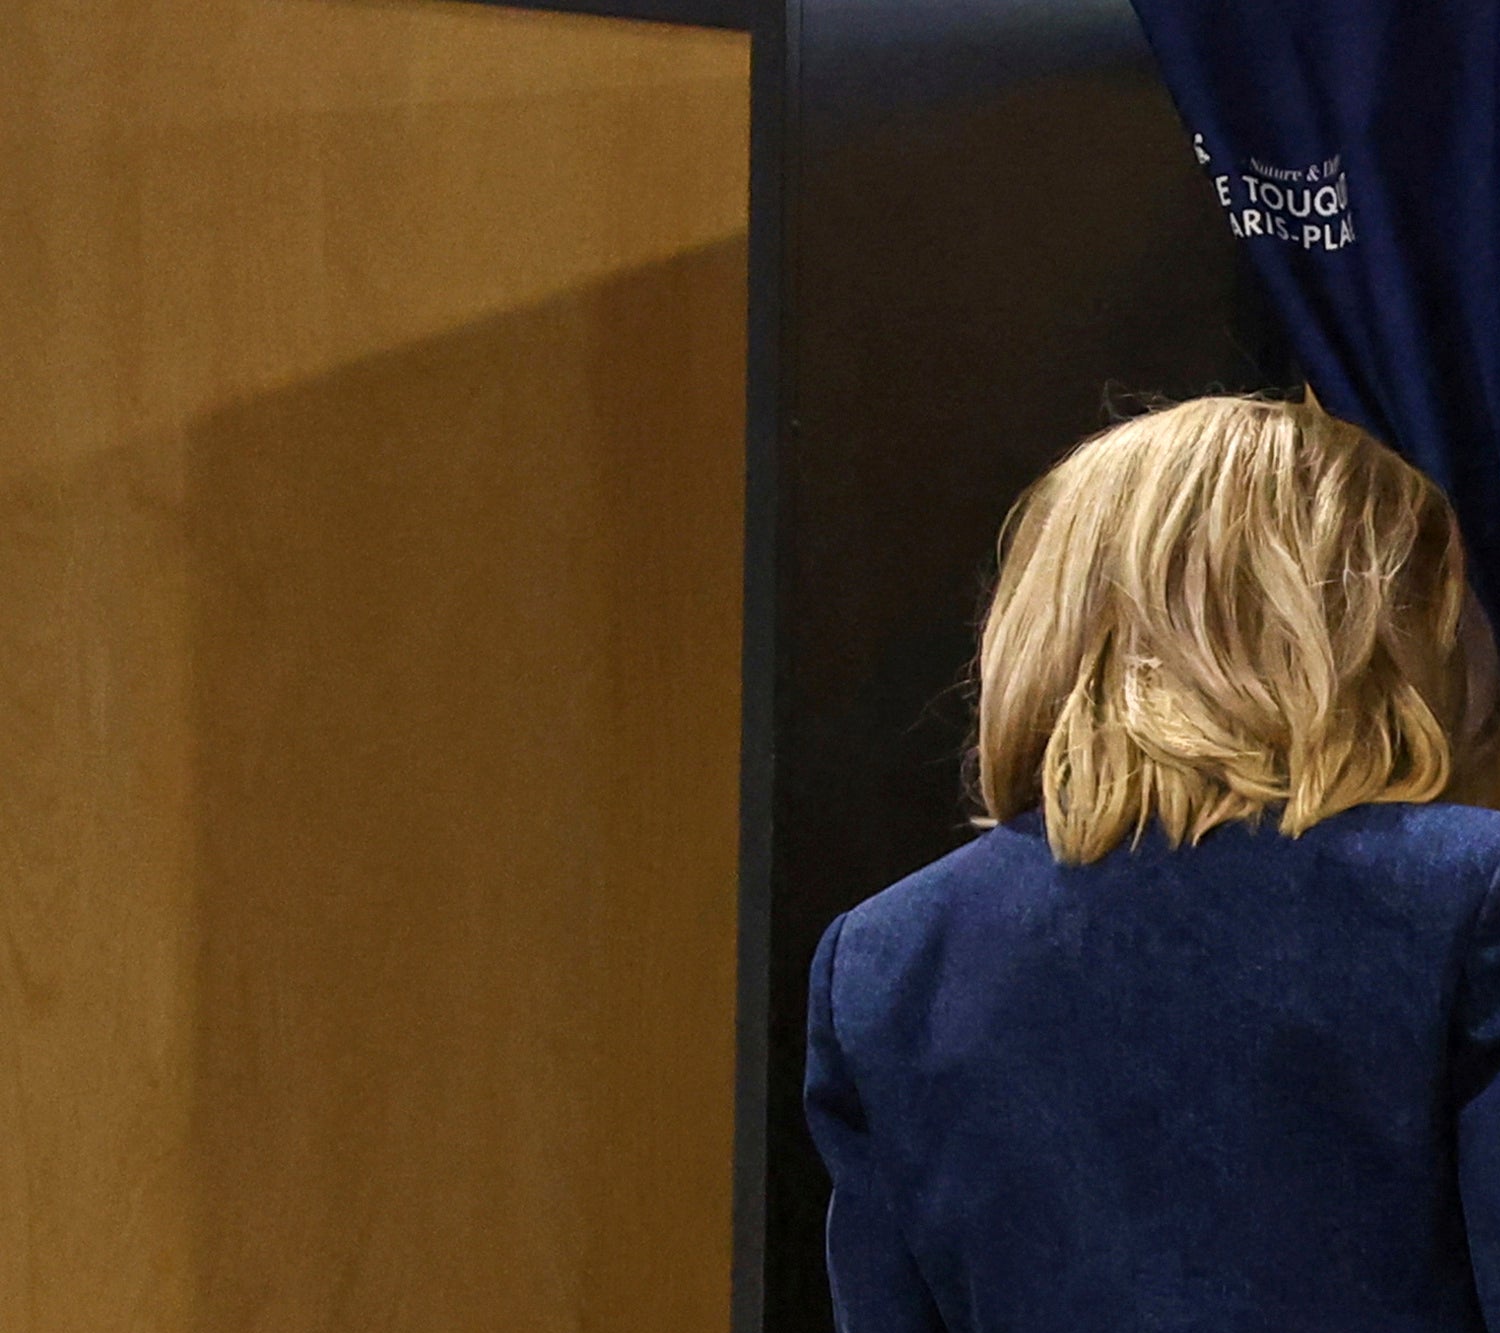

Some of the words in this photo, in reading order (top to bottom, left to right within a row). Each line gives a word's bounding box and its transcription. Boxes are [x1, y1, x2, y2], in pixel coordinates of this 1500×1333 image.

[1306, 164, 1321, 182] &
[1215, 175, 1232, 206] E
[1242, 172, 1349, 217] TOUQU
[1229, 209, 1356, 250] ARIS-PLA
